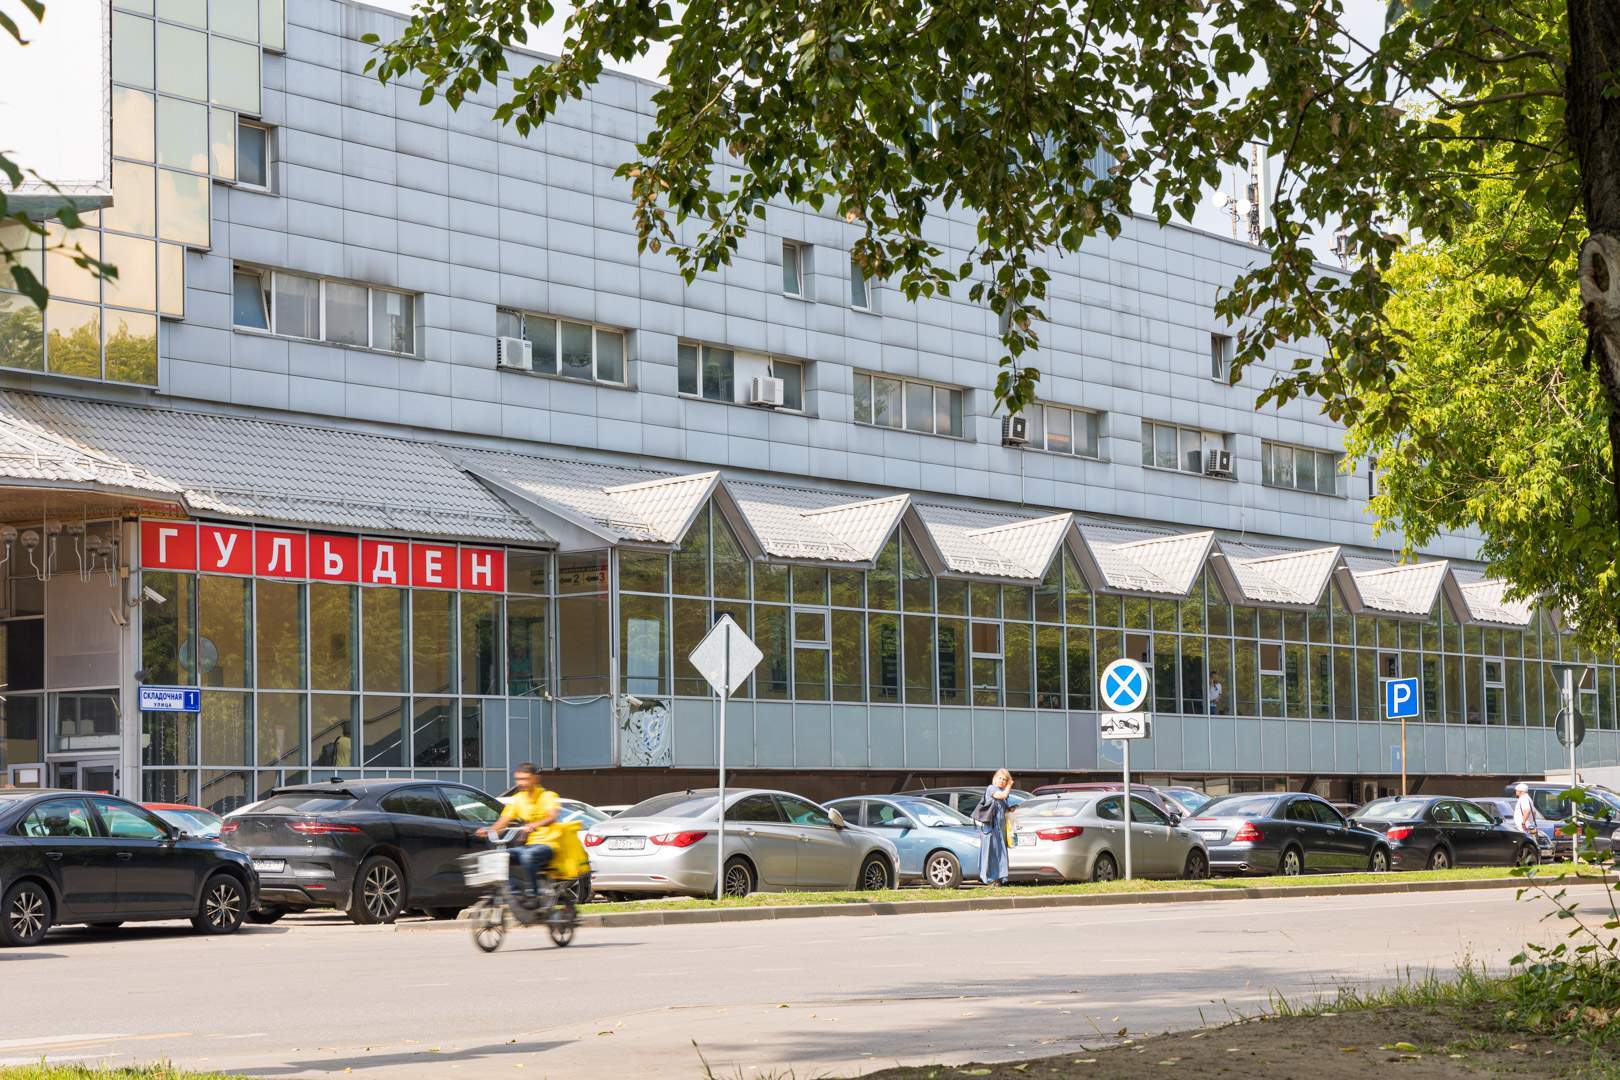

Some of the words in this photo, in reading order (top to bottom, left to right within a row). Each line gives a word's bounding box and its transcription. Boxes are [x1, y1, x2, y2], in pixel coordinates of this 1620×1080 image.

[158, 527, 492, 586] ГУЛЬДЕН
[599, 572, 605, 582] 3
[143, 691, 183, 701] СКЛАДОЧНАЯ
[189, 692, 194, 705] 1
[1393, 683, 1411, 714] P
